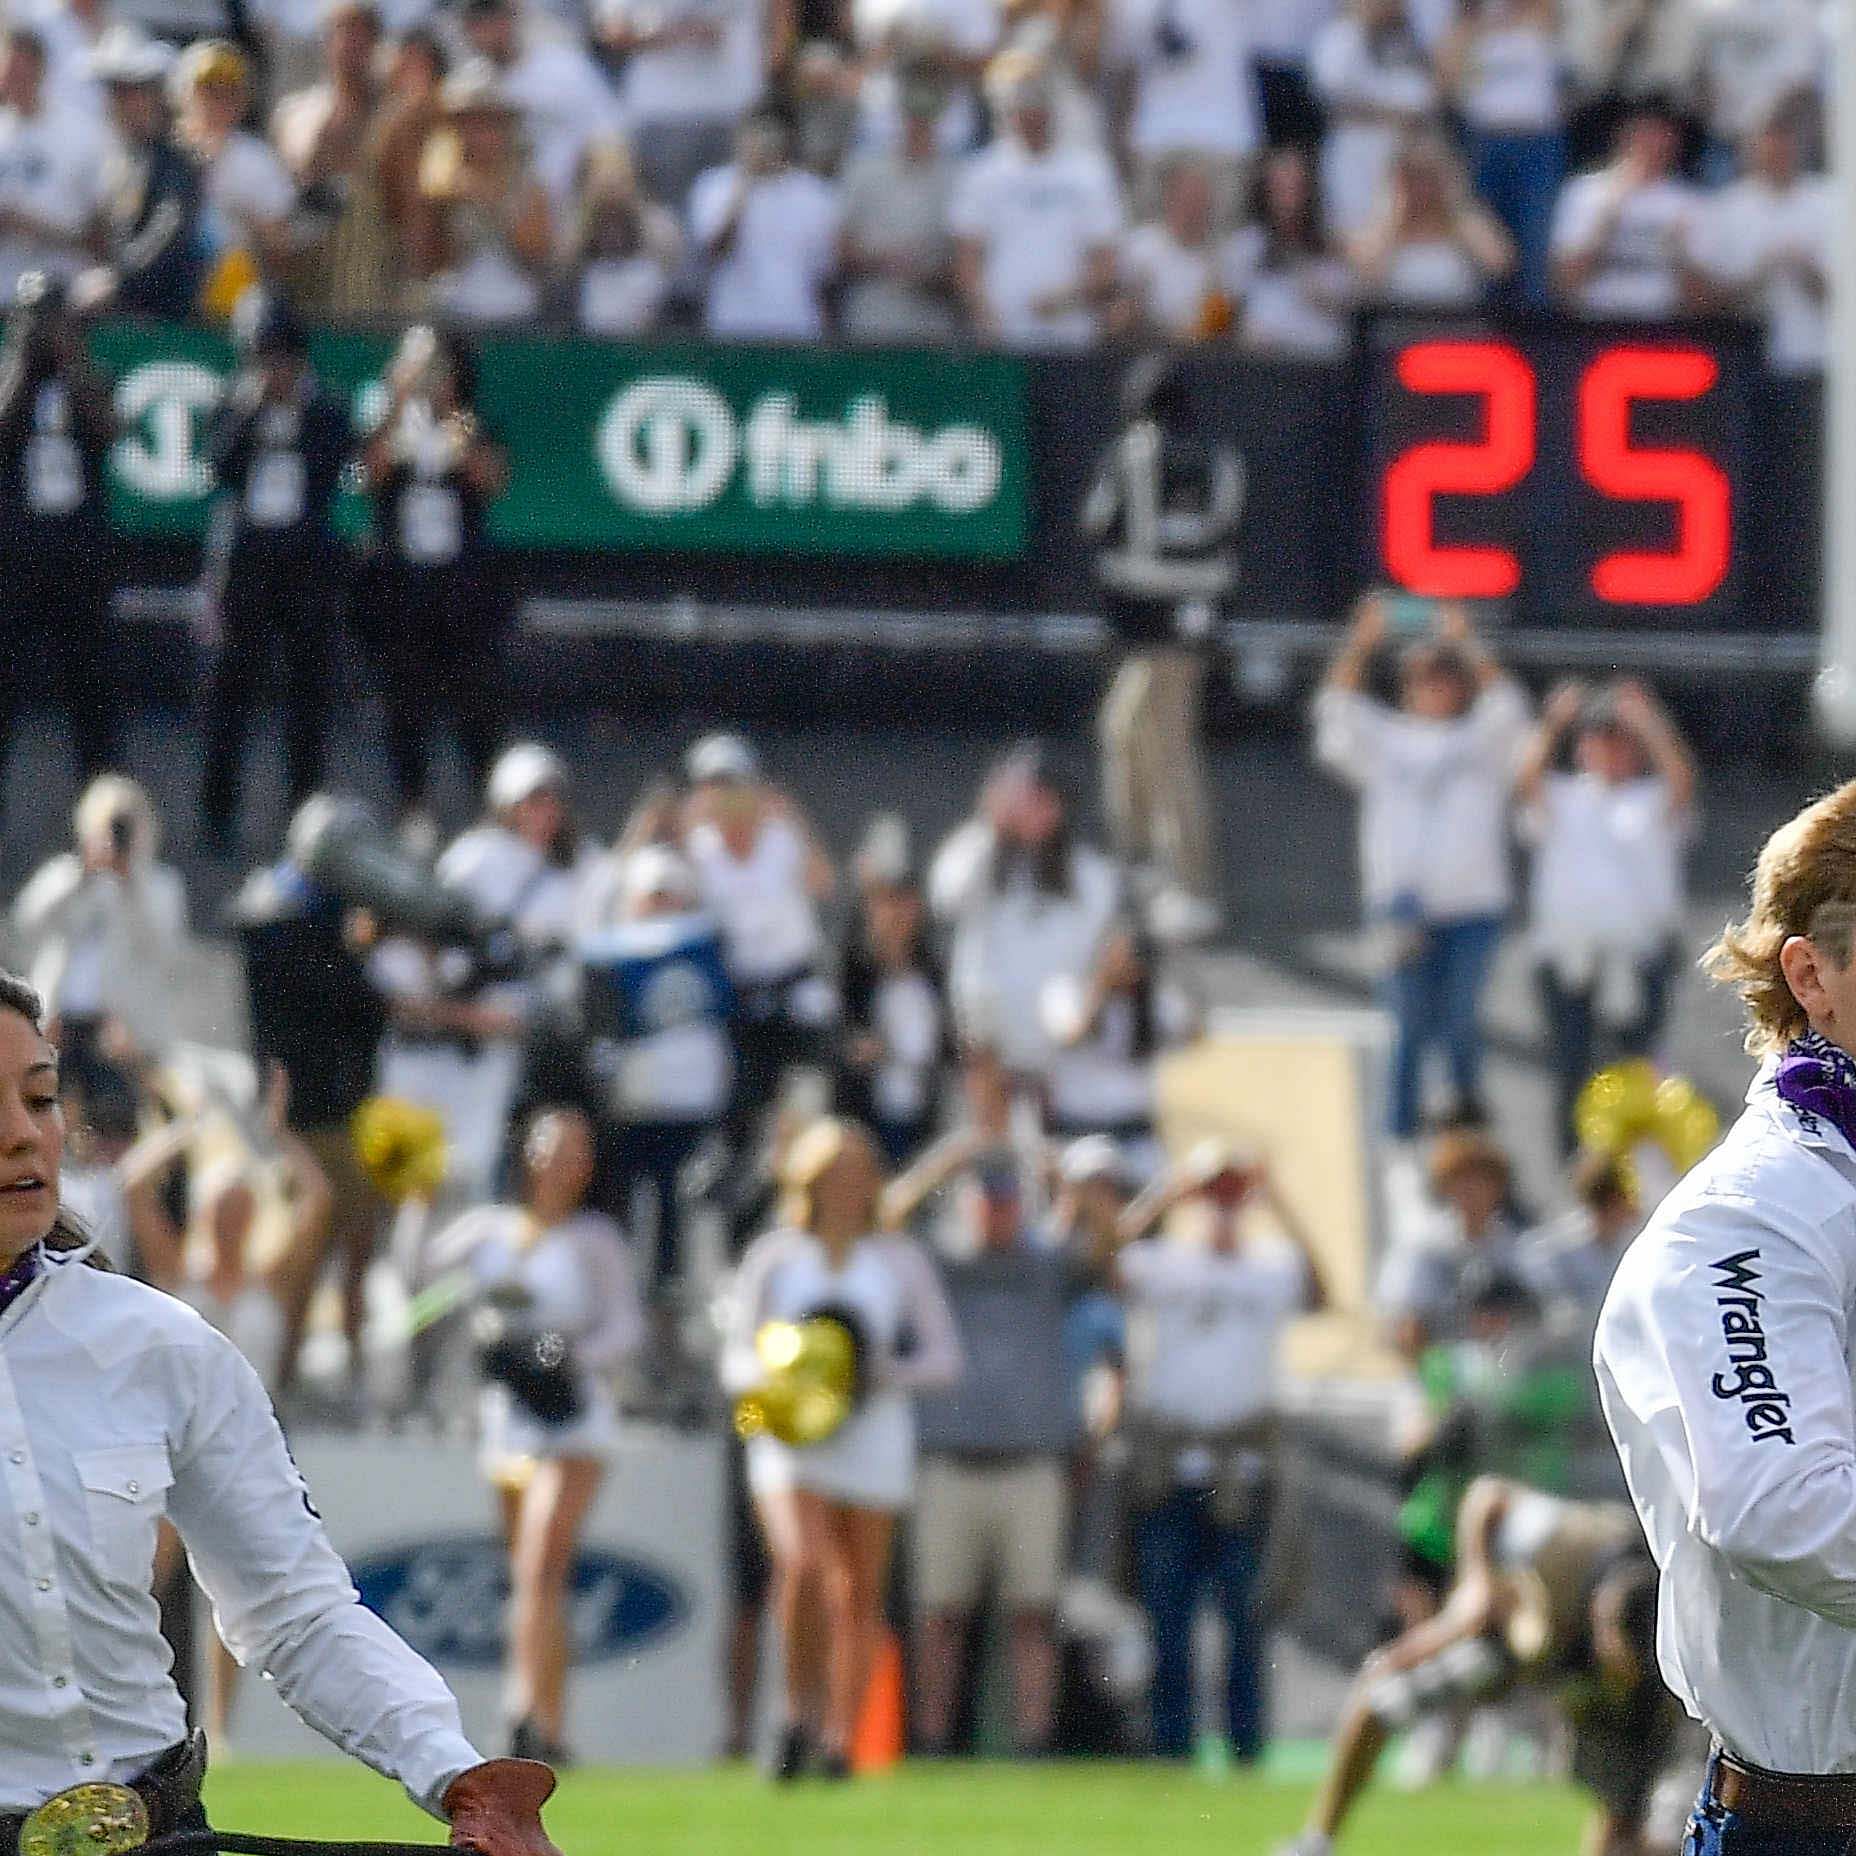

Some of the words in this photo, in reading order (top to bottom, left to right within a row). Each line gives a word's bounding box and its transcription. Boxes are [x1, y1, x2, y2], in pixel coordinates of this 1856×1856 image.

[748, 393, 1000, 512] fnbo
[1381, 342, 1732, 604] 25
[1707, 1248, 1796, 1445] Wrangler
